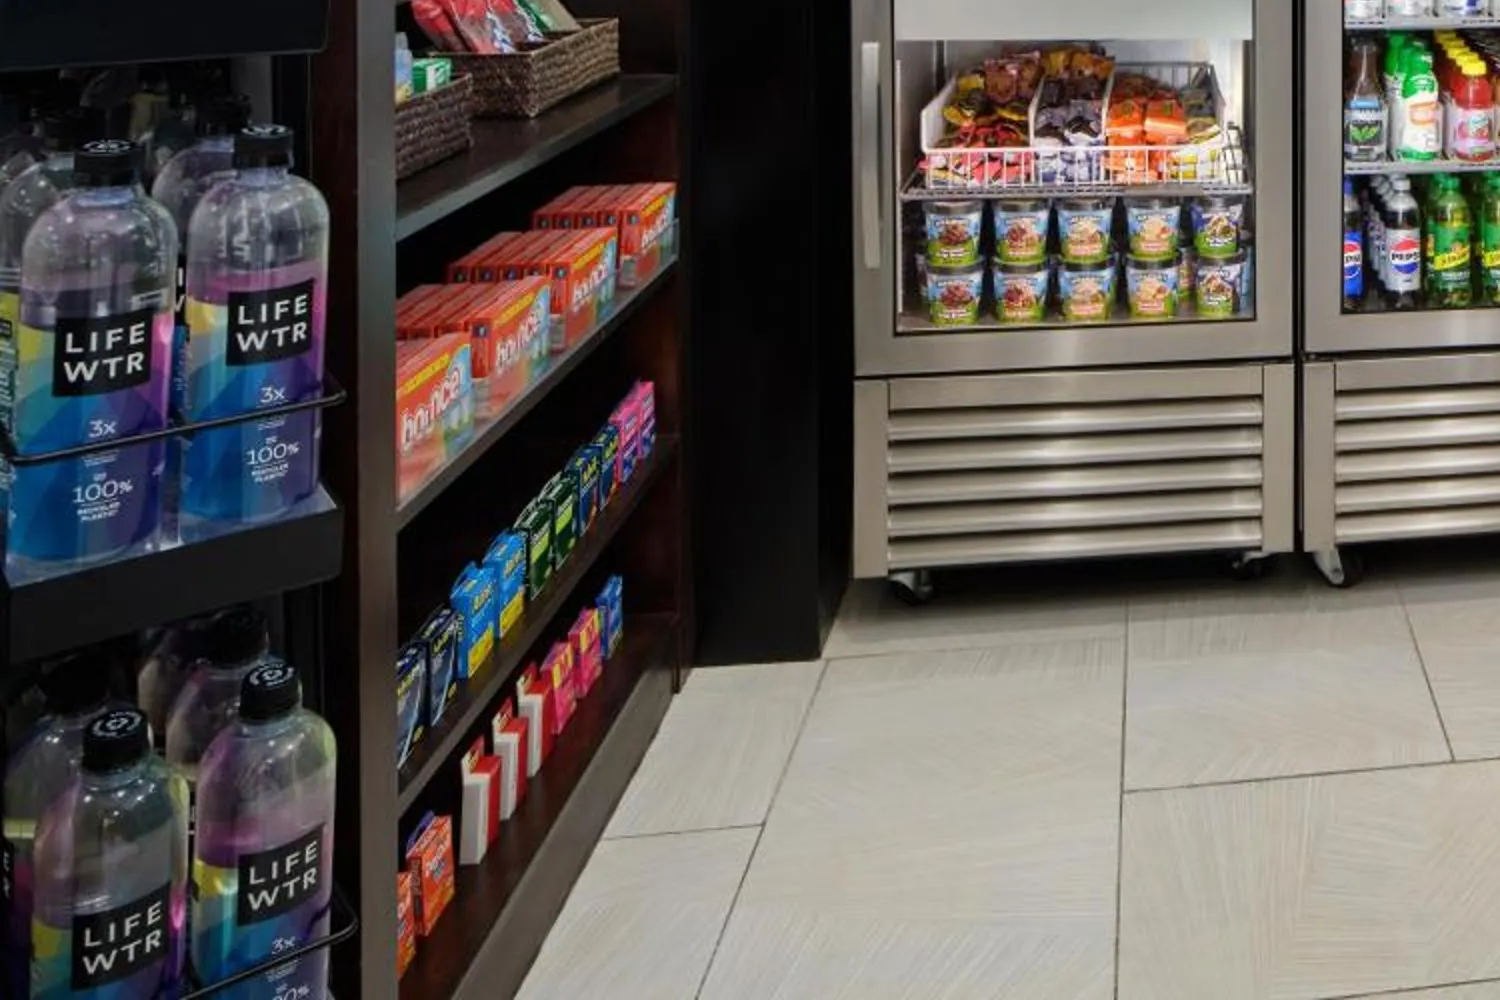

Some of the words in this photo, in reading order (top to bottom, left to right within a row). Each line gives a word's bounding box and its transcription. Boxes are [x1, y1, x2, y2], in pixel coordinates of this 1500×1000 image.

[238, 294, 308, 326] LIFE
[66, 322, 146, 354] LIFE
[236, 322, 307, 353] WTR
[63, 351, 144, 383] WTR
[260, 386, 286, 403] 3x
[89, 419, 116, 438] 3x
[246, 441, 300, 465] 100%
[72, 480, 134, 503] 100%
[250, 840, 318, 885] LIFE
[247, 867, 318, 912] WTR
[84, 901, 162, 948] LIFE
[82, 929, 162, 977] WTR
